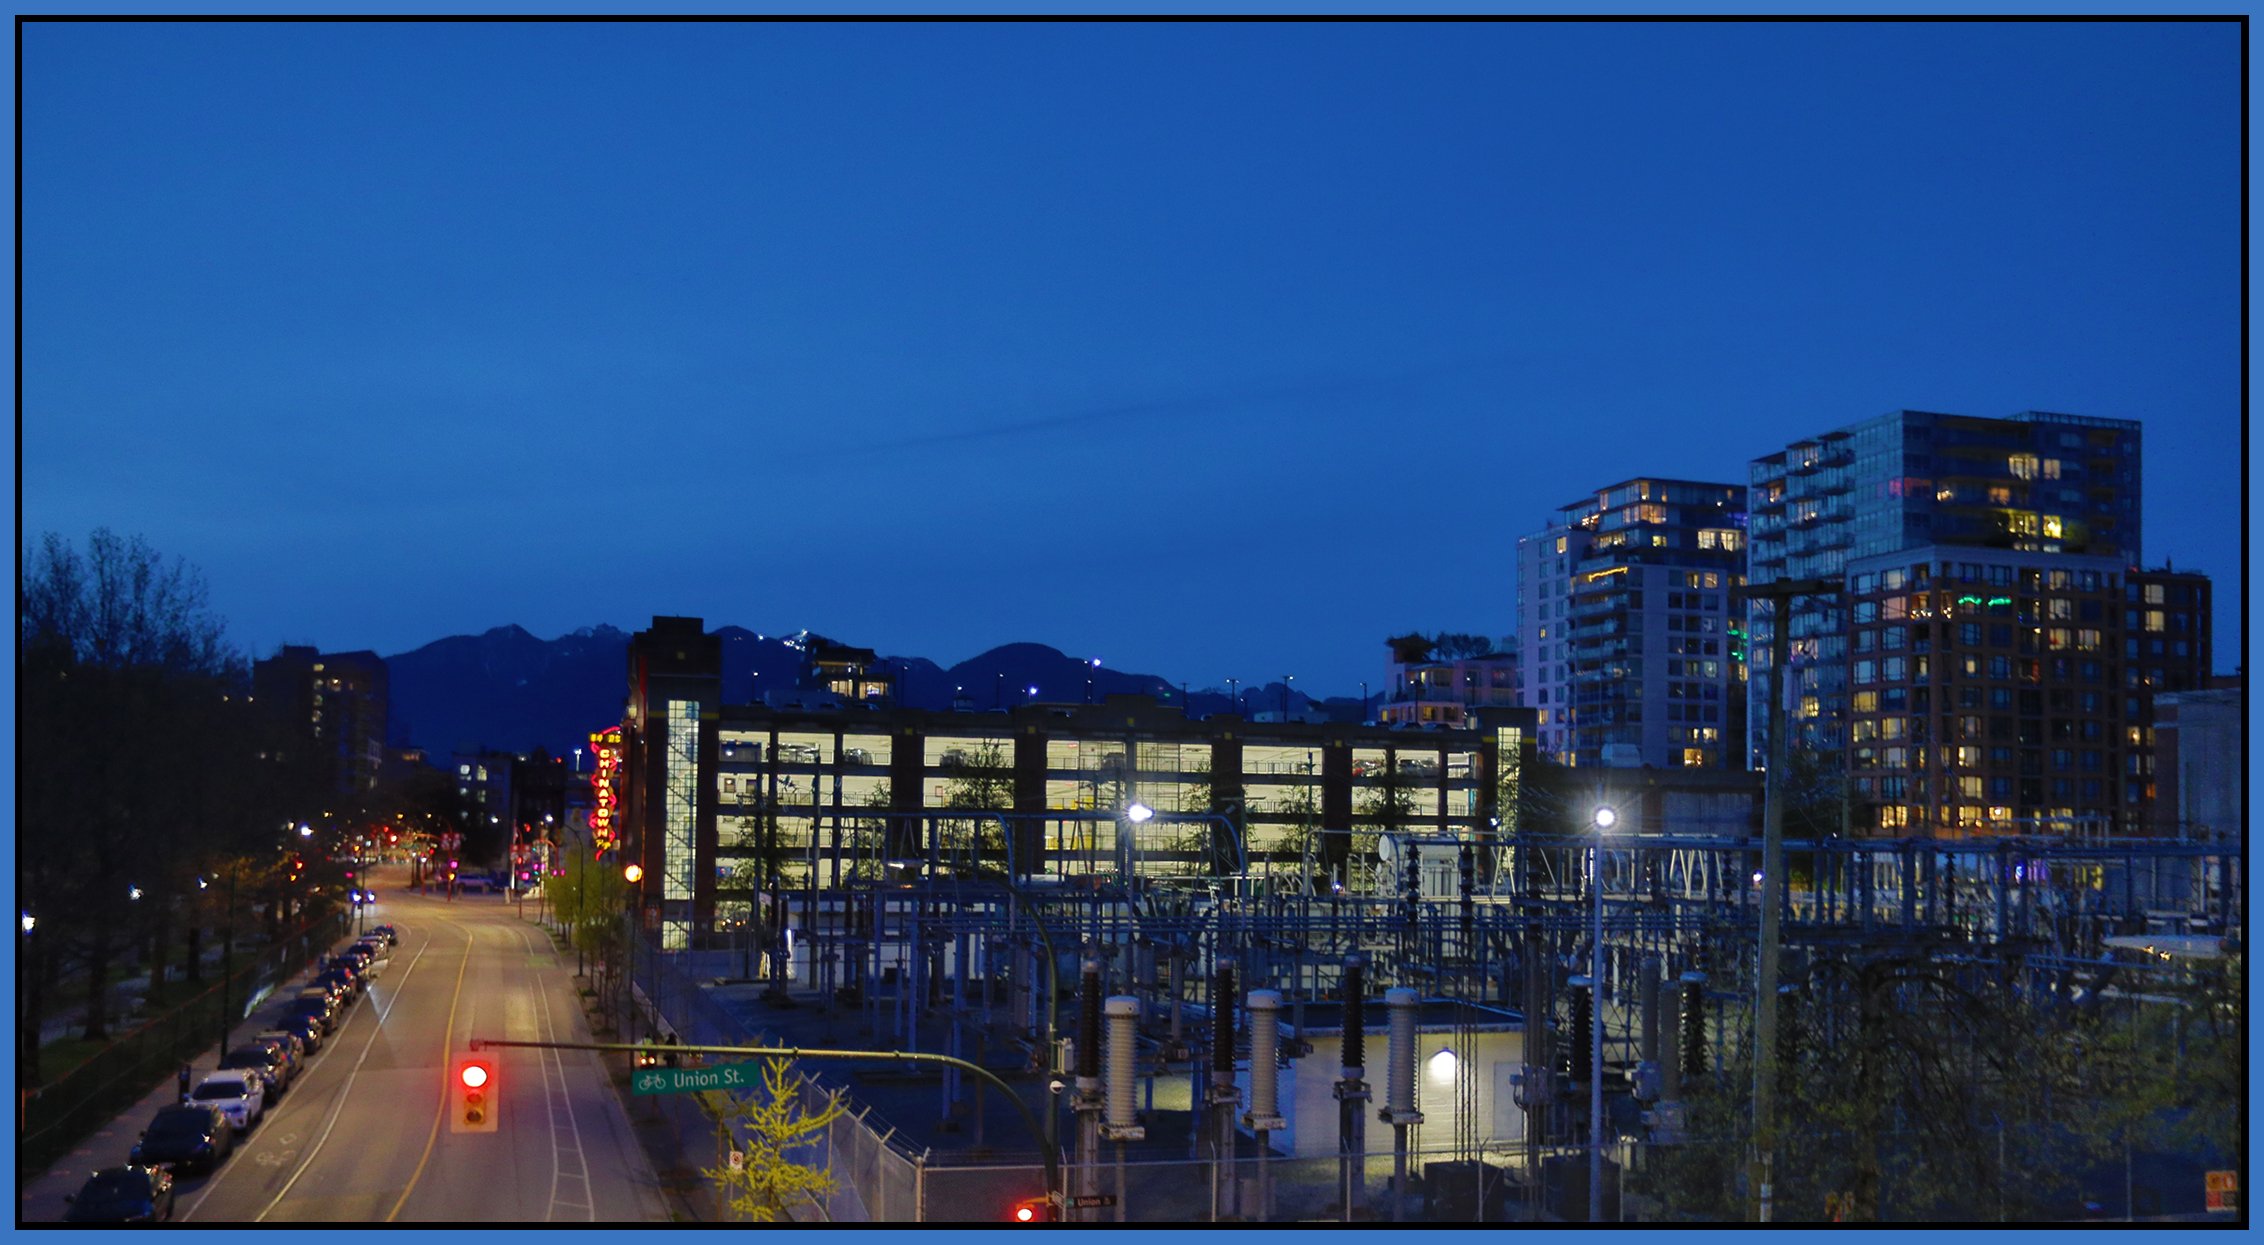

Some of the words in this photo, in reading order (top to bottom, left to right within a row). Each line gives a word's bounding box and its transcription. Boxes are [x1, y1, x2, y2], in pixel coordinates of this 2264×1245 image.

[597, 749, 610, 837] CHINATOWN
[673, 1071, 719, 1088] Union
[724, 1068, 745, 1084] St.
[1077, 1198, 1102, 1207] Union
